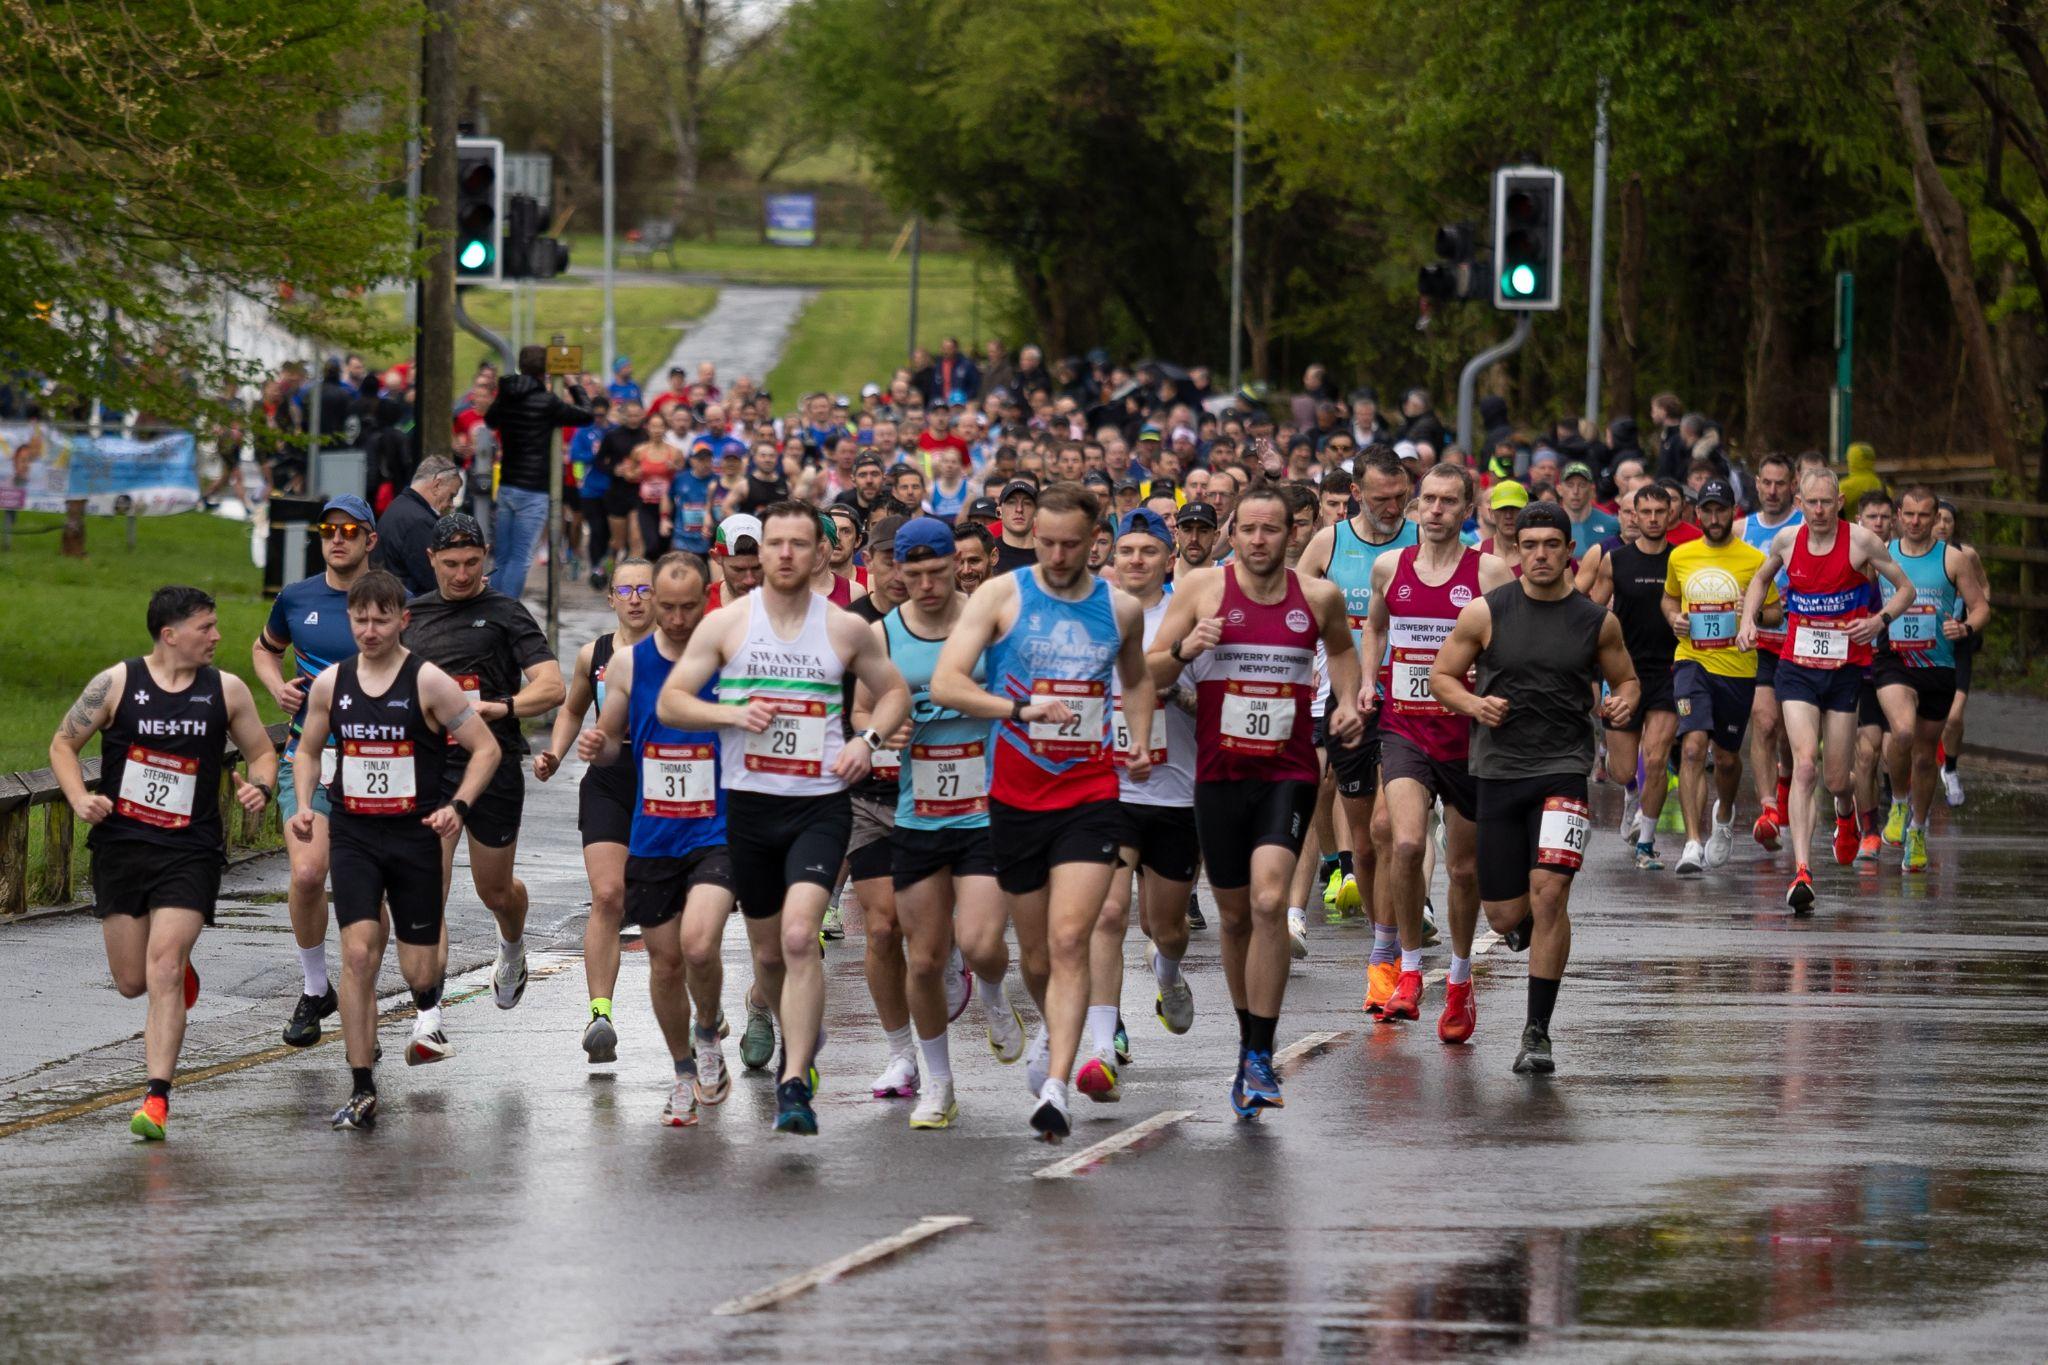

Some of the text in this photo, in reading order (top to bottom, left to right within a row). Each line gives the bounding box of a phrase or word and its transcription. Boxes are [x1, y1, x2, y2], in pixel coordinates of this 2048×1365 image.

[1704, 623, 1720, 637] 73
[1903, 625, 1919, 638] 92
[1812, 639, 1829, 655] 36
[751, 651, 822, 667] SWANSEA
[747, 664, 826, 680] HARRIERS
[1239, 664, 1291, 675] NEWPORT
[1409, 666, 1430, 676] EDDIE
[1410, 677, 1431, 697] 20
[1061, 700, 1083, 711] RAIG
[1250, 701, 1267, 711] DAN
[1246, 713, 1270, 736] 30
[772, 731, 797, 755] 29
[1117, 726, 1129, 748] 5
[363, 761, 391, 771] FINLAY
[660, 763, 692, 774] THOMAS
[937, 763, 956, 773] SAM
[142, 768, 180, 785] STEPHEN
[366, 773, 389, 794] 23
[665, 776, 685, 797] 31
[937, 775, 960, 797] 27
[144, 782, 170, 807] 32
[1564, 827, 1583, 849] 43
